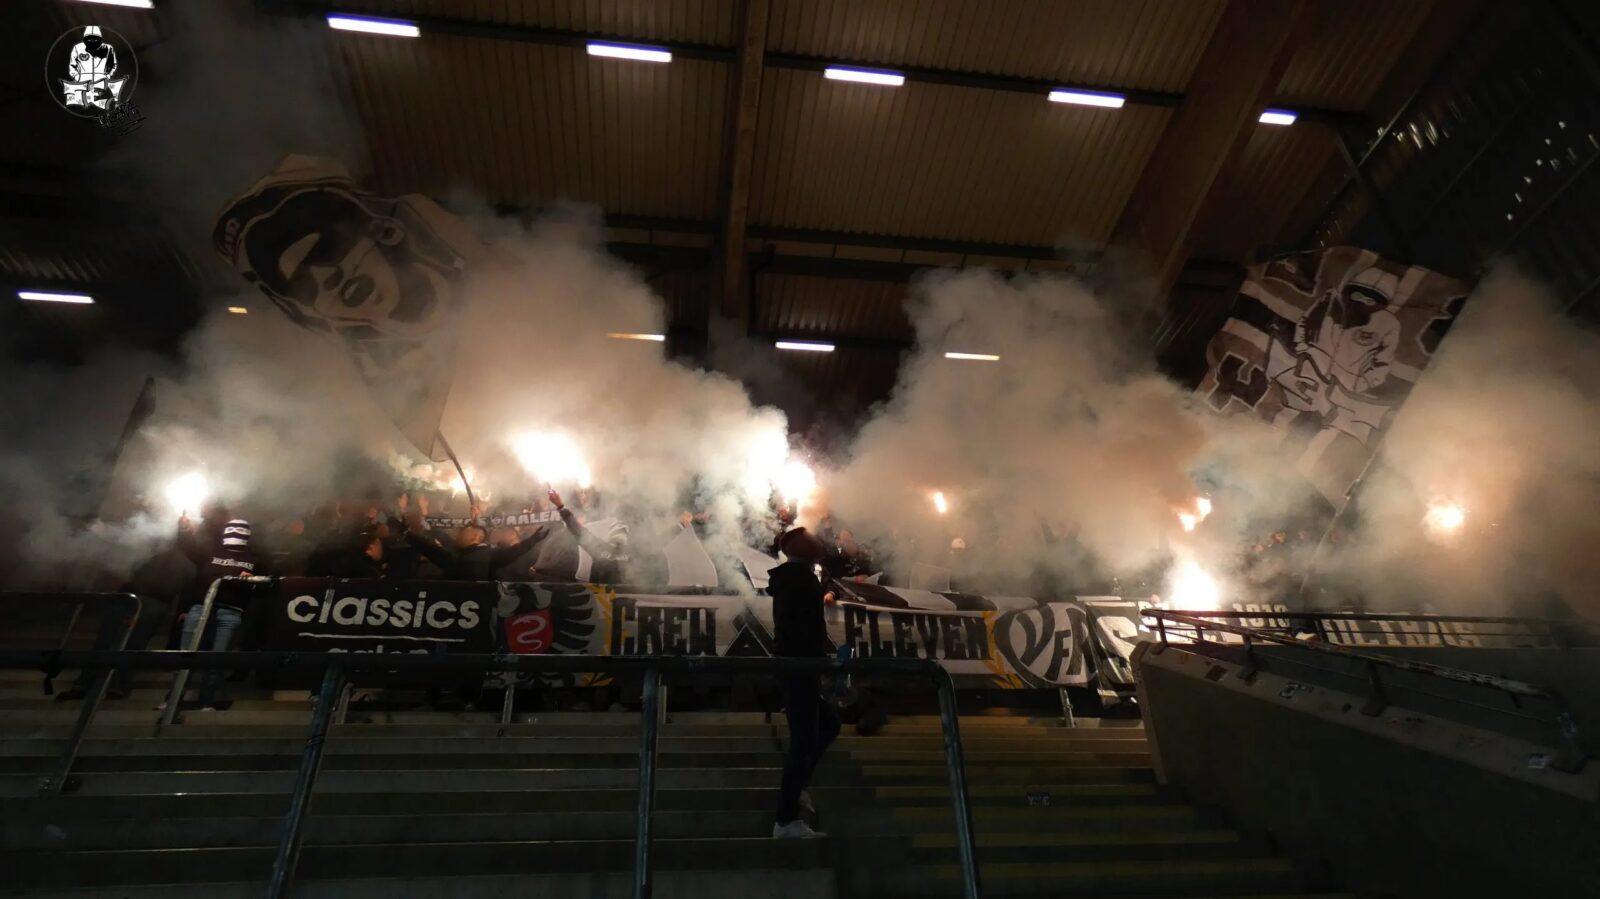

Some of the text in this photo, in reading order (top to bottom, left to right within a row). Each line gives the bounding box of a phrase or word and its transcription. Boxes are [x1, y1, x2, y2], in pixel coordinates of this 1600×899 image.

[287, 589, 481, 630] classics
[612, 598, 991, 660] CREW ELEVEN
